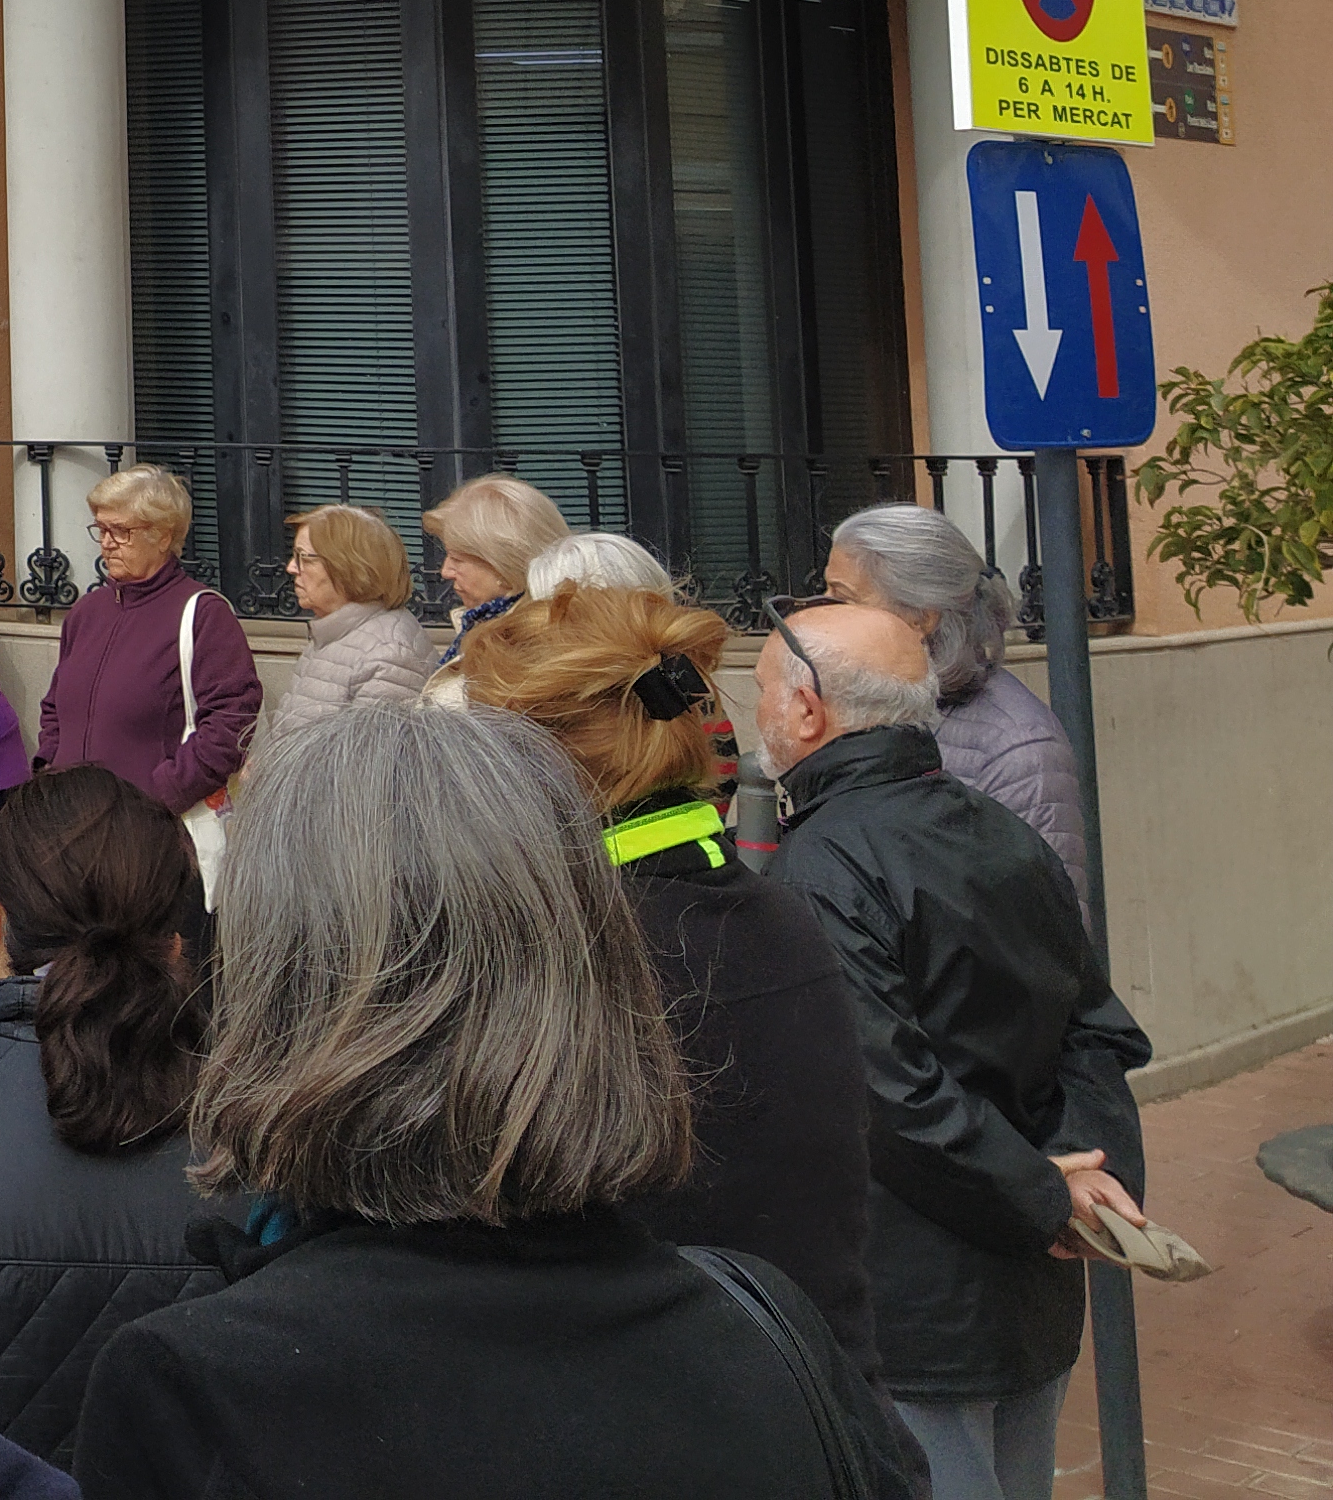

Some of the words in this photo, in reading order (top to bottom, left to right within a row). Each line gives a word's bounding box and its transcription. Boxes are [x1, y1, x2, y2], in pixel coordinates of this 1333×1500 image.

[985, 47, 1100, 78] DISSABTES
[1111, 63, 1137, 83] DE
[1018, 76, 1030, 94] 6
[1040, 79, 1055, 97] A
[998, 99, 1041, 120] PER
[1052, 104, 1133, 130] MERCAT
